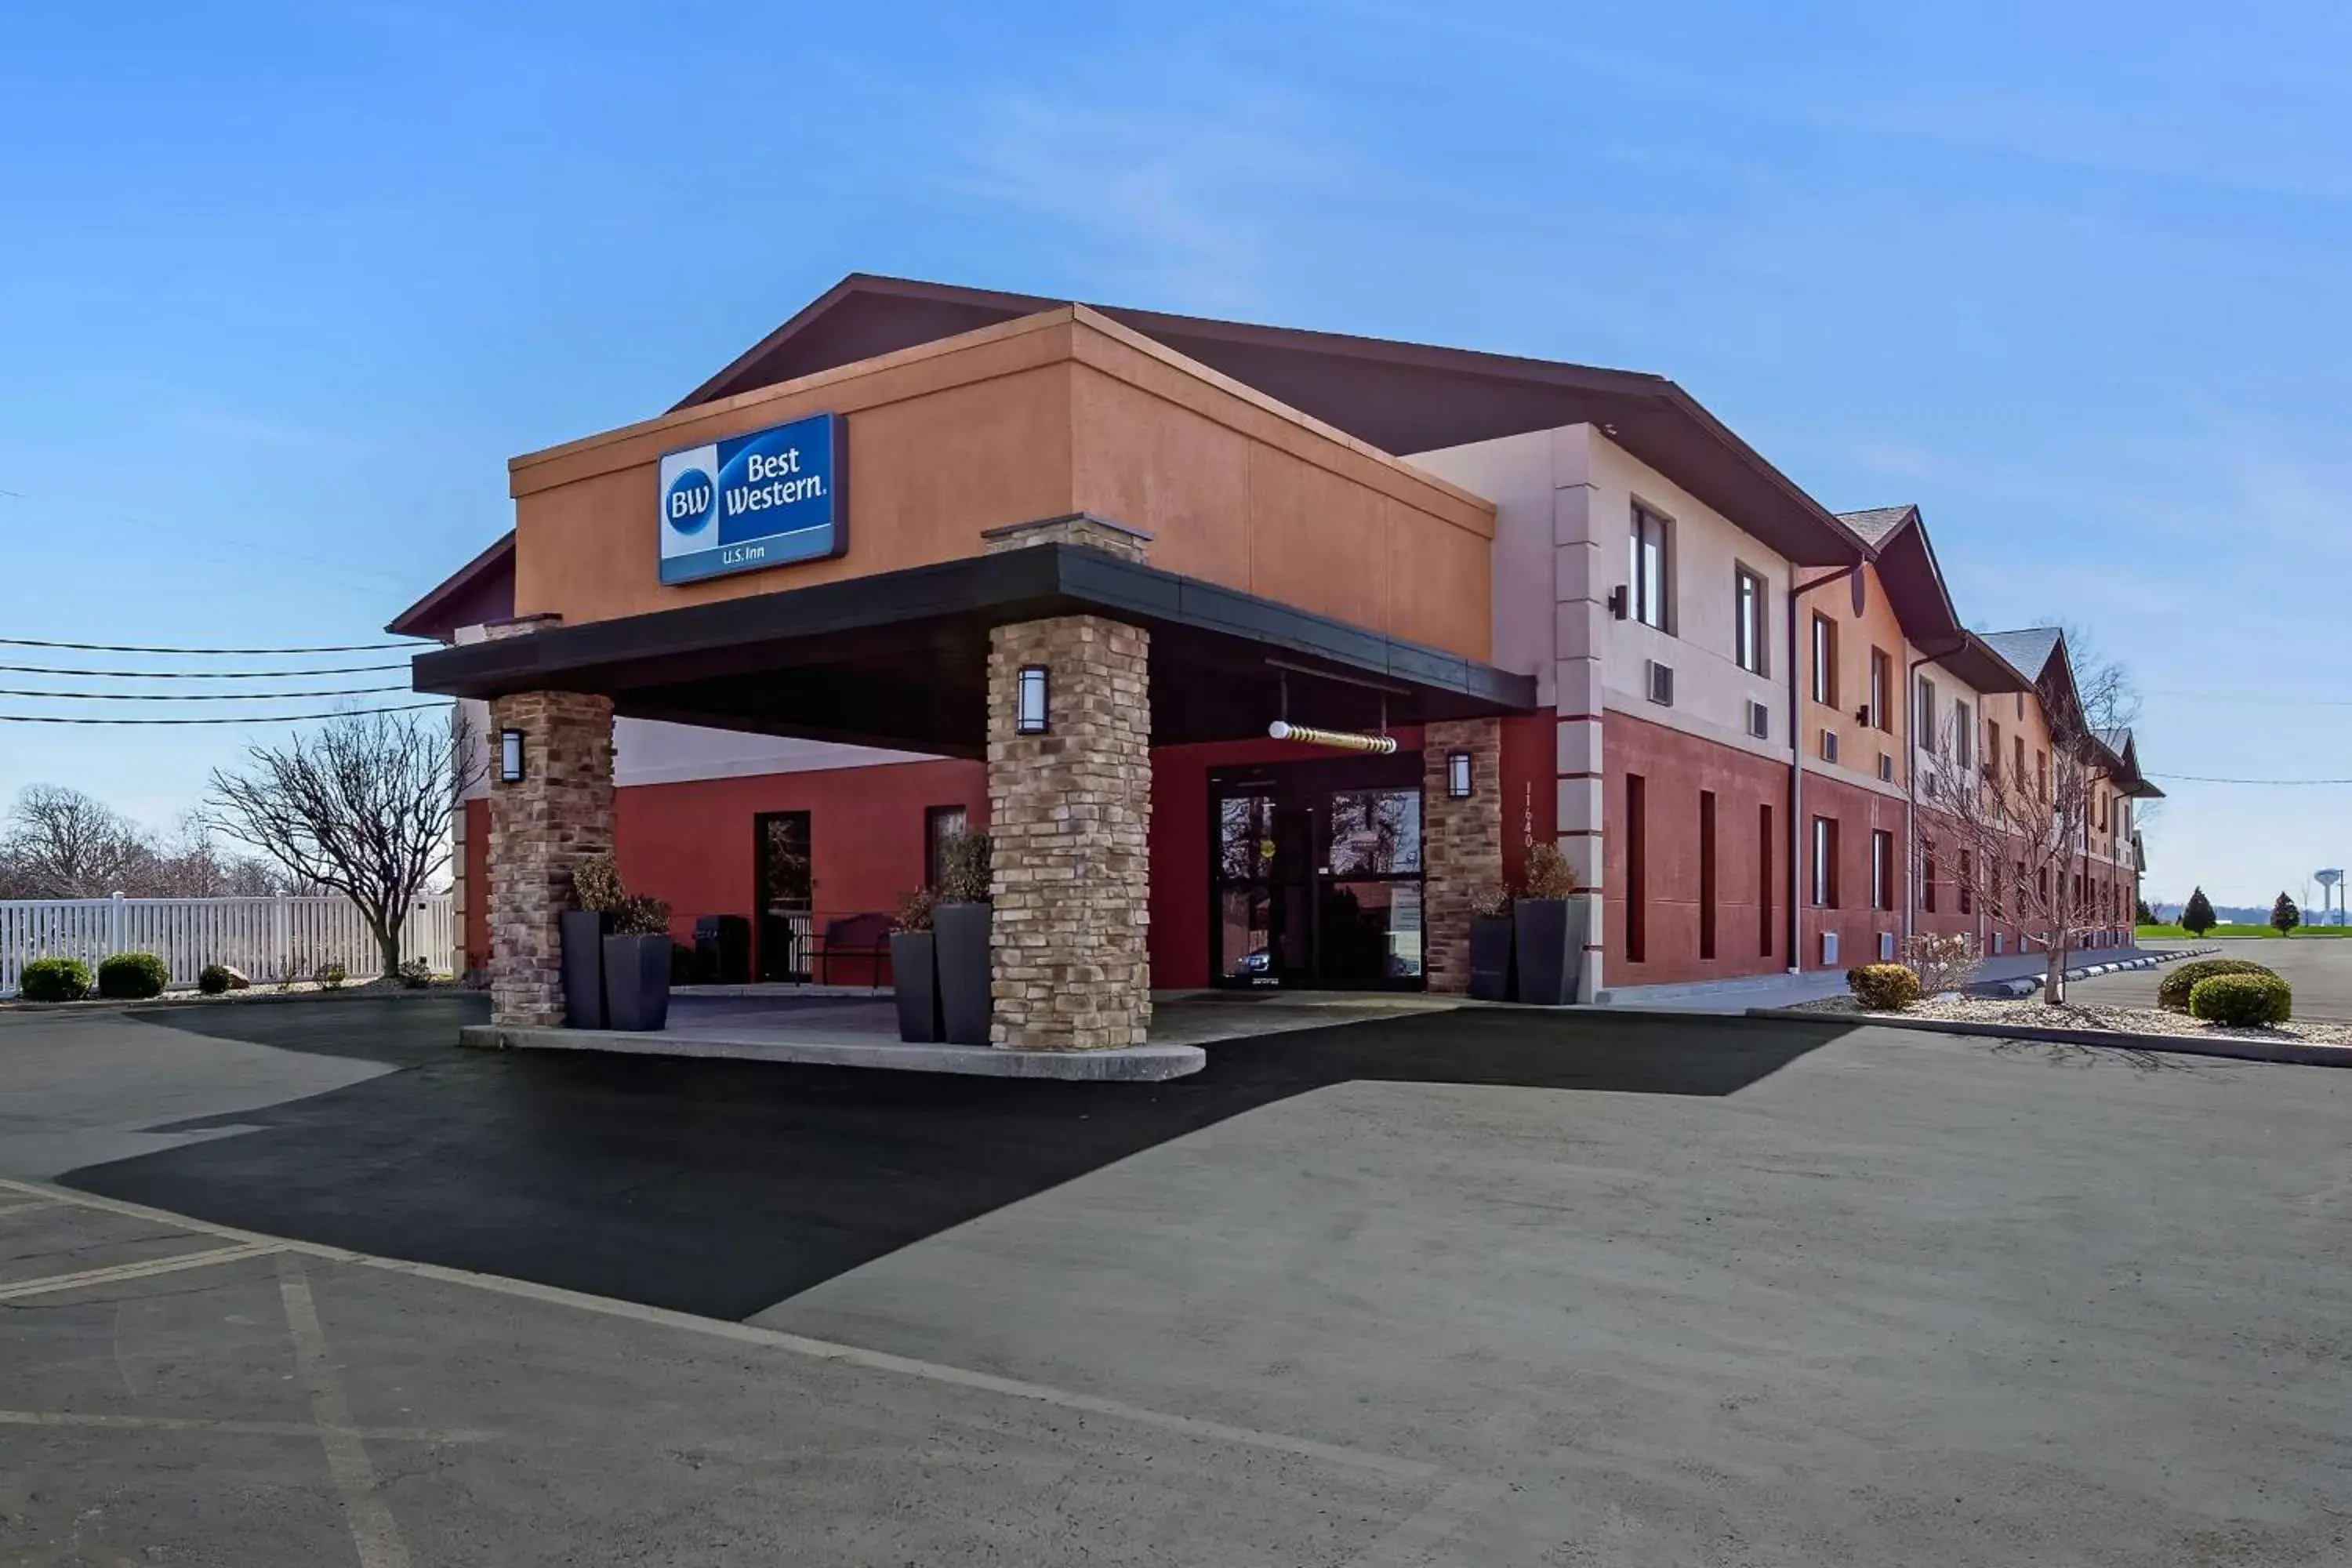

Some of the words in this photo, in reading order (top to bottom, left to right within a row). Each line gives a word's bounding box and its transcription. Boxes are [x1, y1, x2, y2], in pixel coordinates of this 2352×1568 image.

[748, 448, 800, 482] Best
[672, 485, 710, 518] BW
[724, 548, 744, 564] U.S.
[746, 546, 764, 561] Inn
[1524, 781, 1533, 848] 11640
